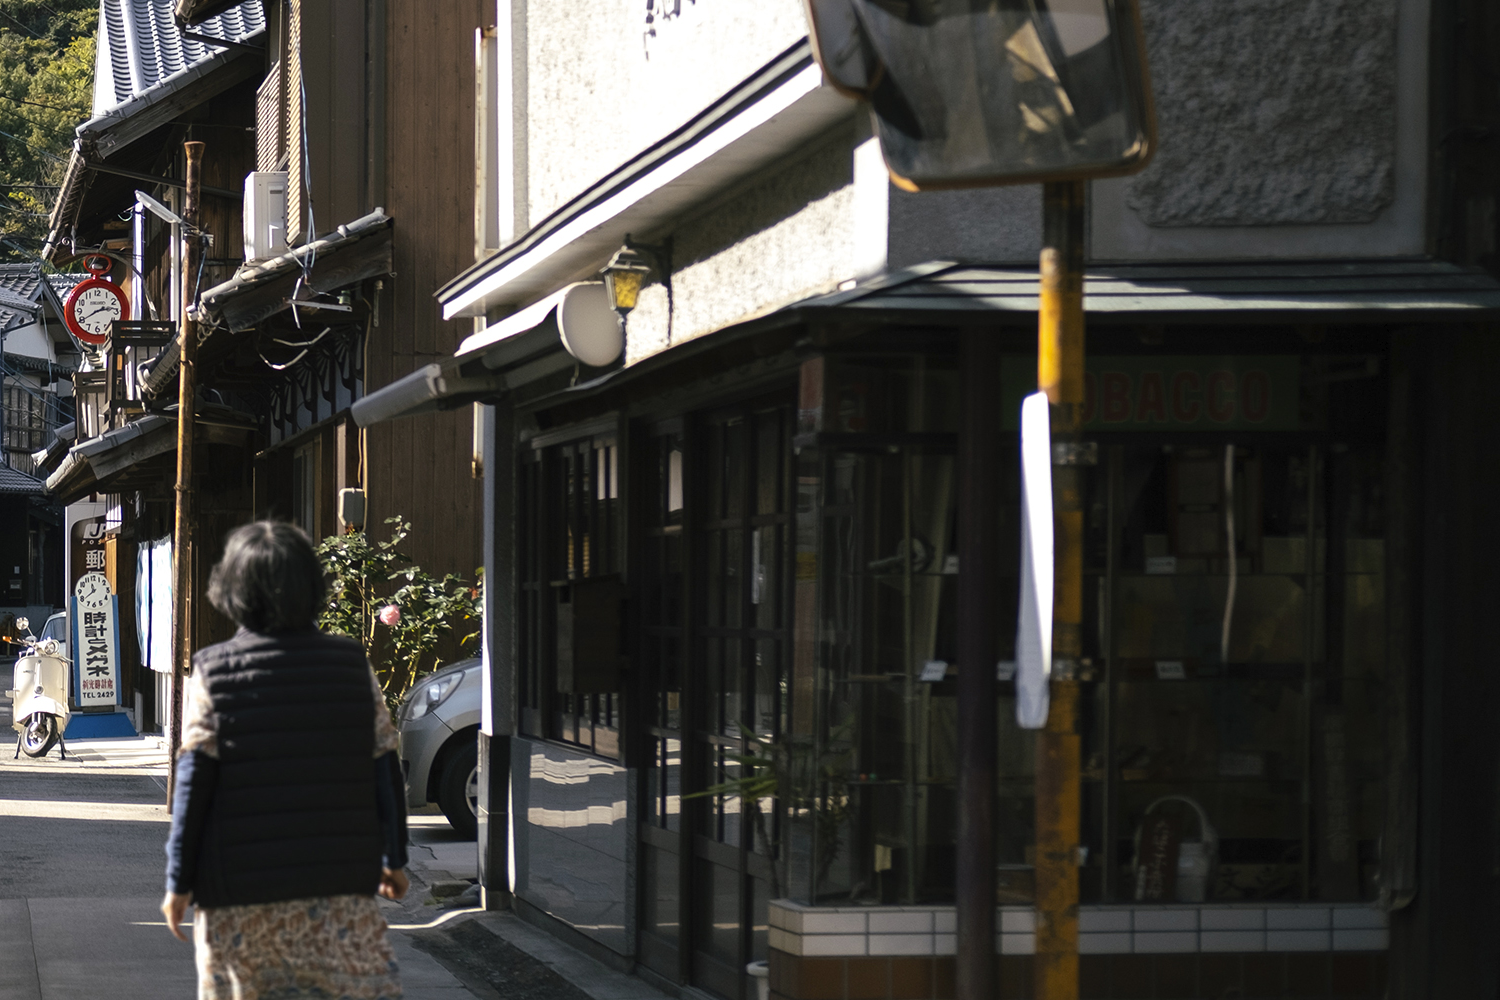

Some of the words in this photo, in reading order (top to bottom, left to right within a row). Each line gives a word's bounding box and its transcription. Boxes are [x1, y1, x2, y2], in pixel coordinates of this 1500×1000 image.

[111, 298, 117, 306] 2
[113, 307, 119, 315] 3
[85, 323, 91, 331] 7
[95, 325, 100, 333] 6
[1084, 370, 1269, 423] BACCO
[80, 595, 85, 603] 8
[84, 611, 110, 677] 時計とメガネ
[82, 691, 96, 699] TEL
[97, 690, 114, 698] 2429
